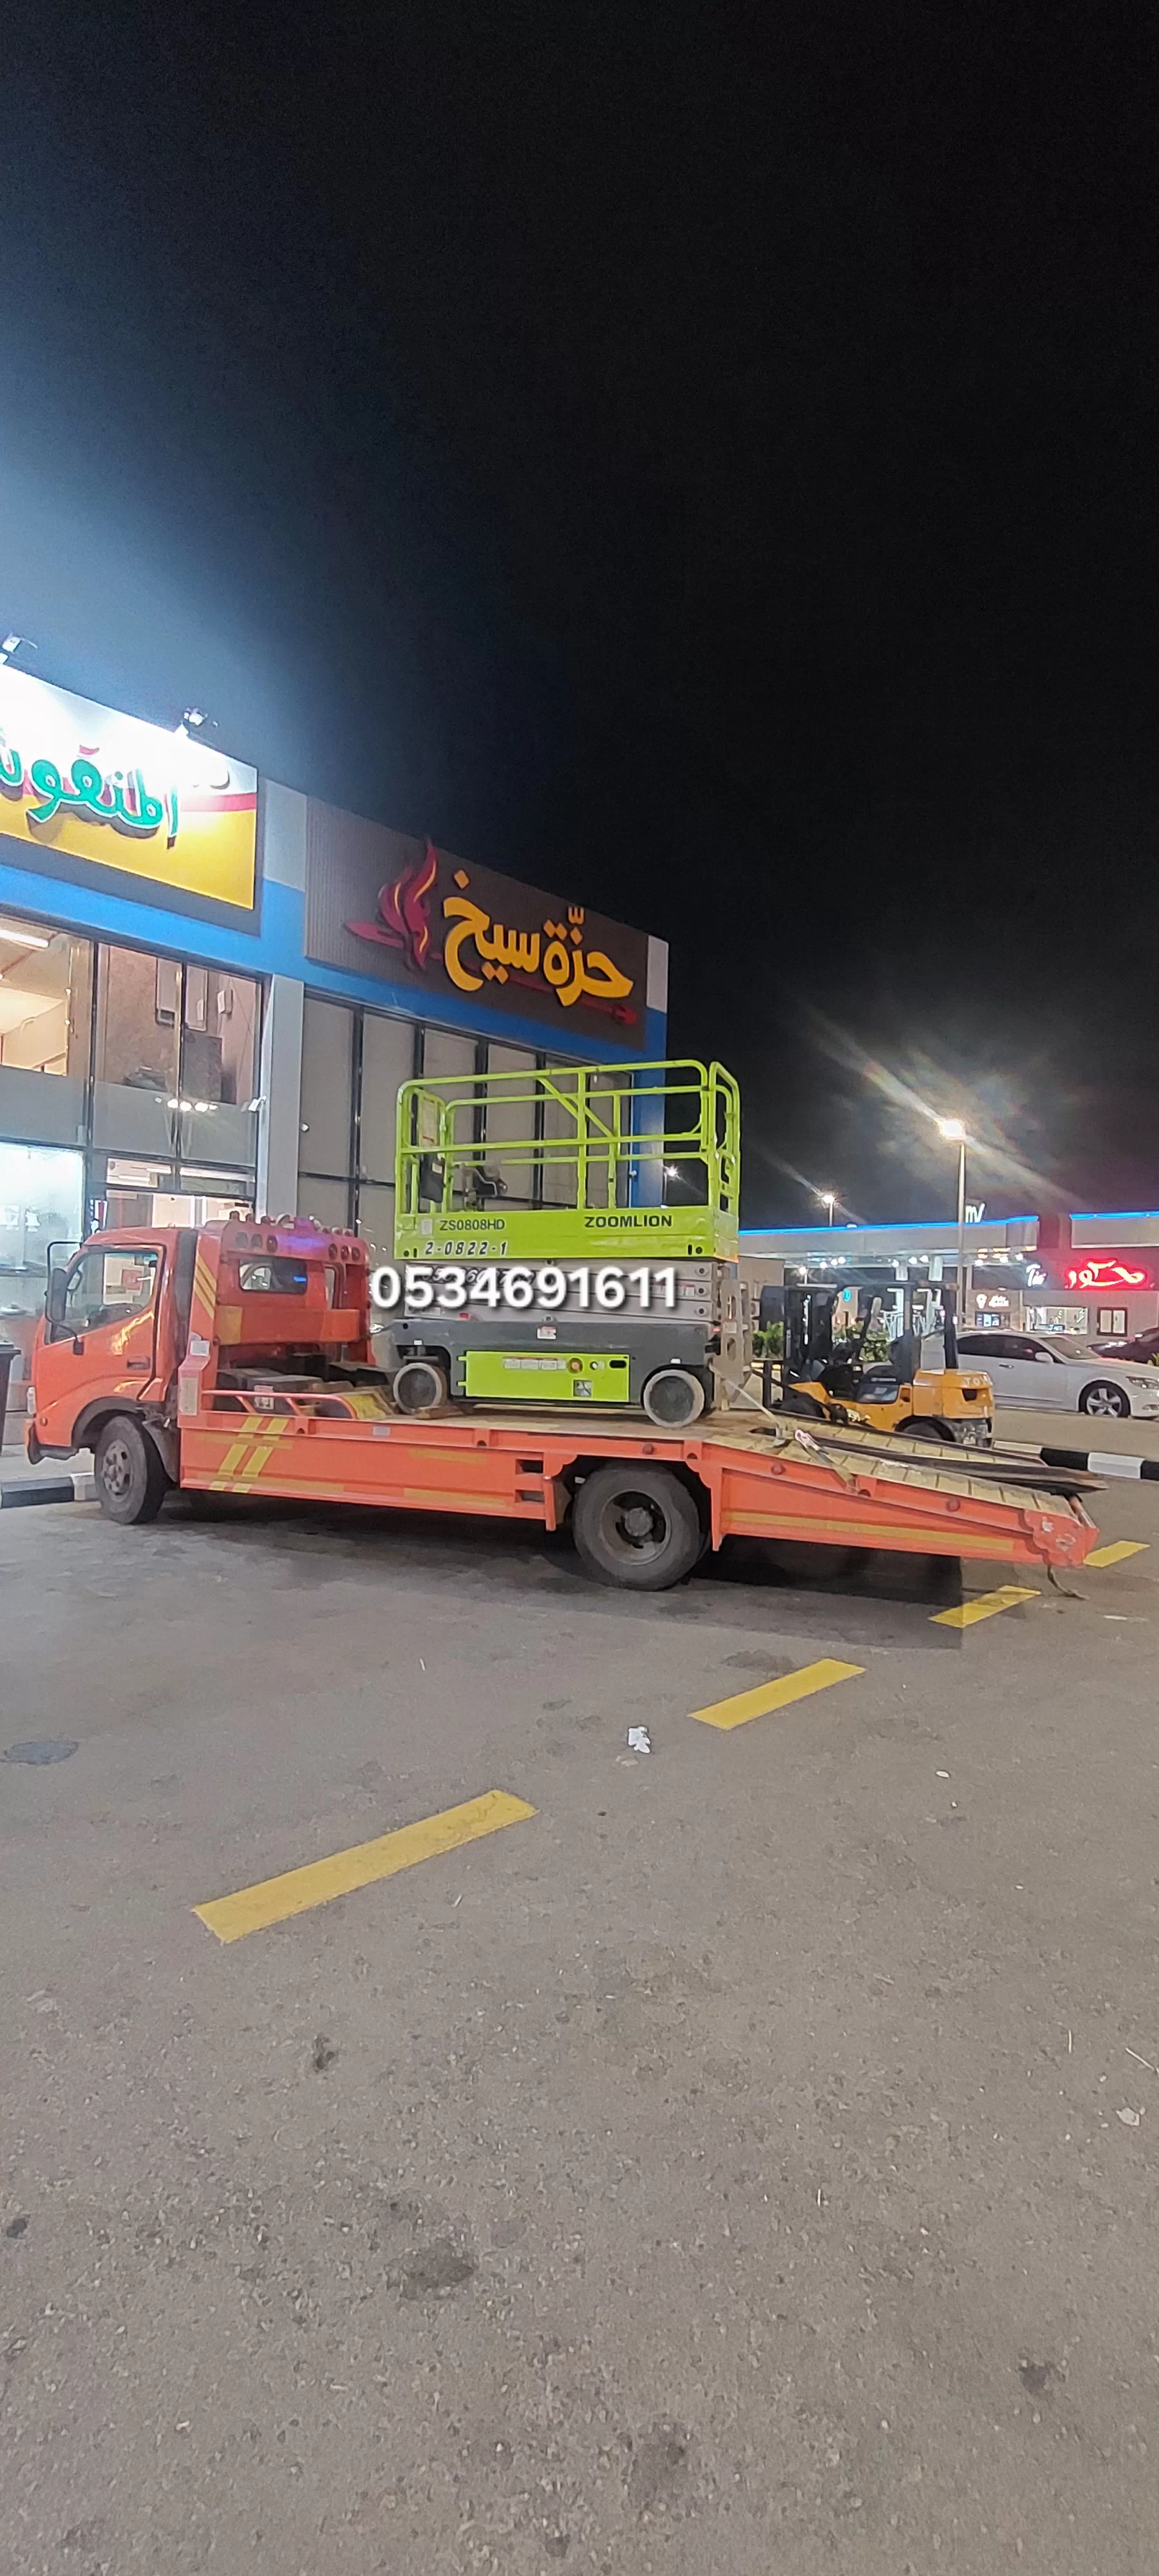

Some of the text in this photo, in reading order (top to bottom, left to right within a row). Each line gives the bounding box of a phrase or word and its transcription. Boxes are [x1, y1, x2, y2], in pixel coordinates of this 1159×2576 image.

[444, 869, 541, 992] سيخ
[439, 1218, 505, 1231] ZS0808HD
[584, 1215, 672, 1228] ZOOMLION
